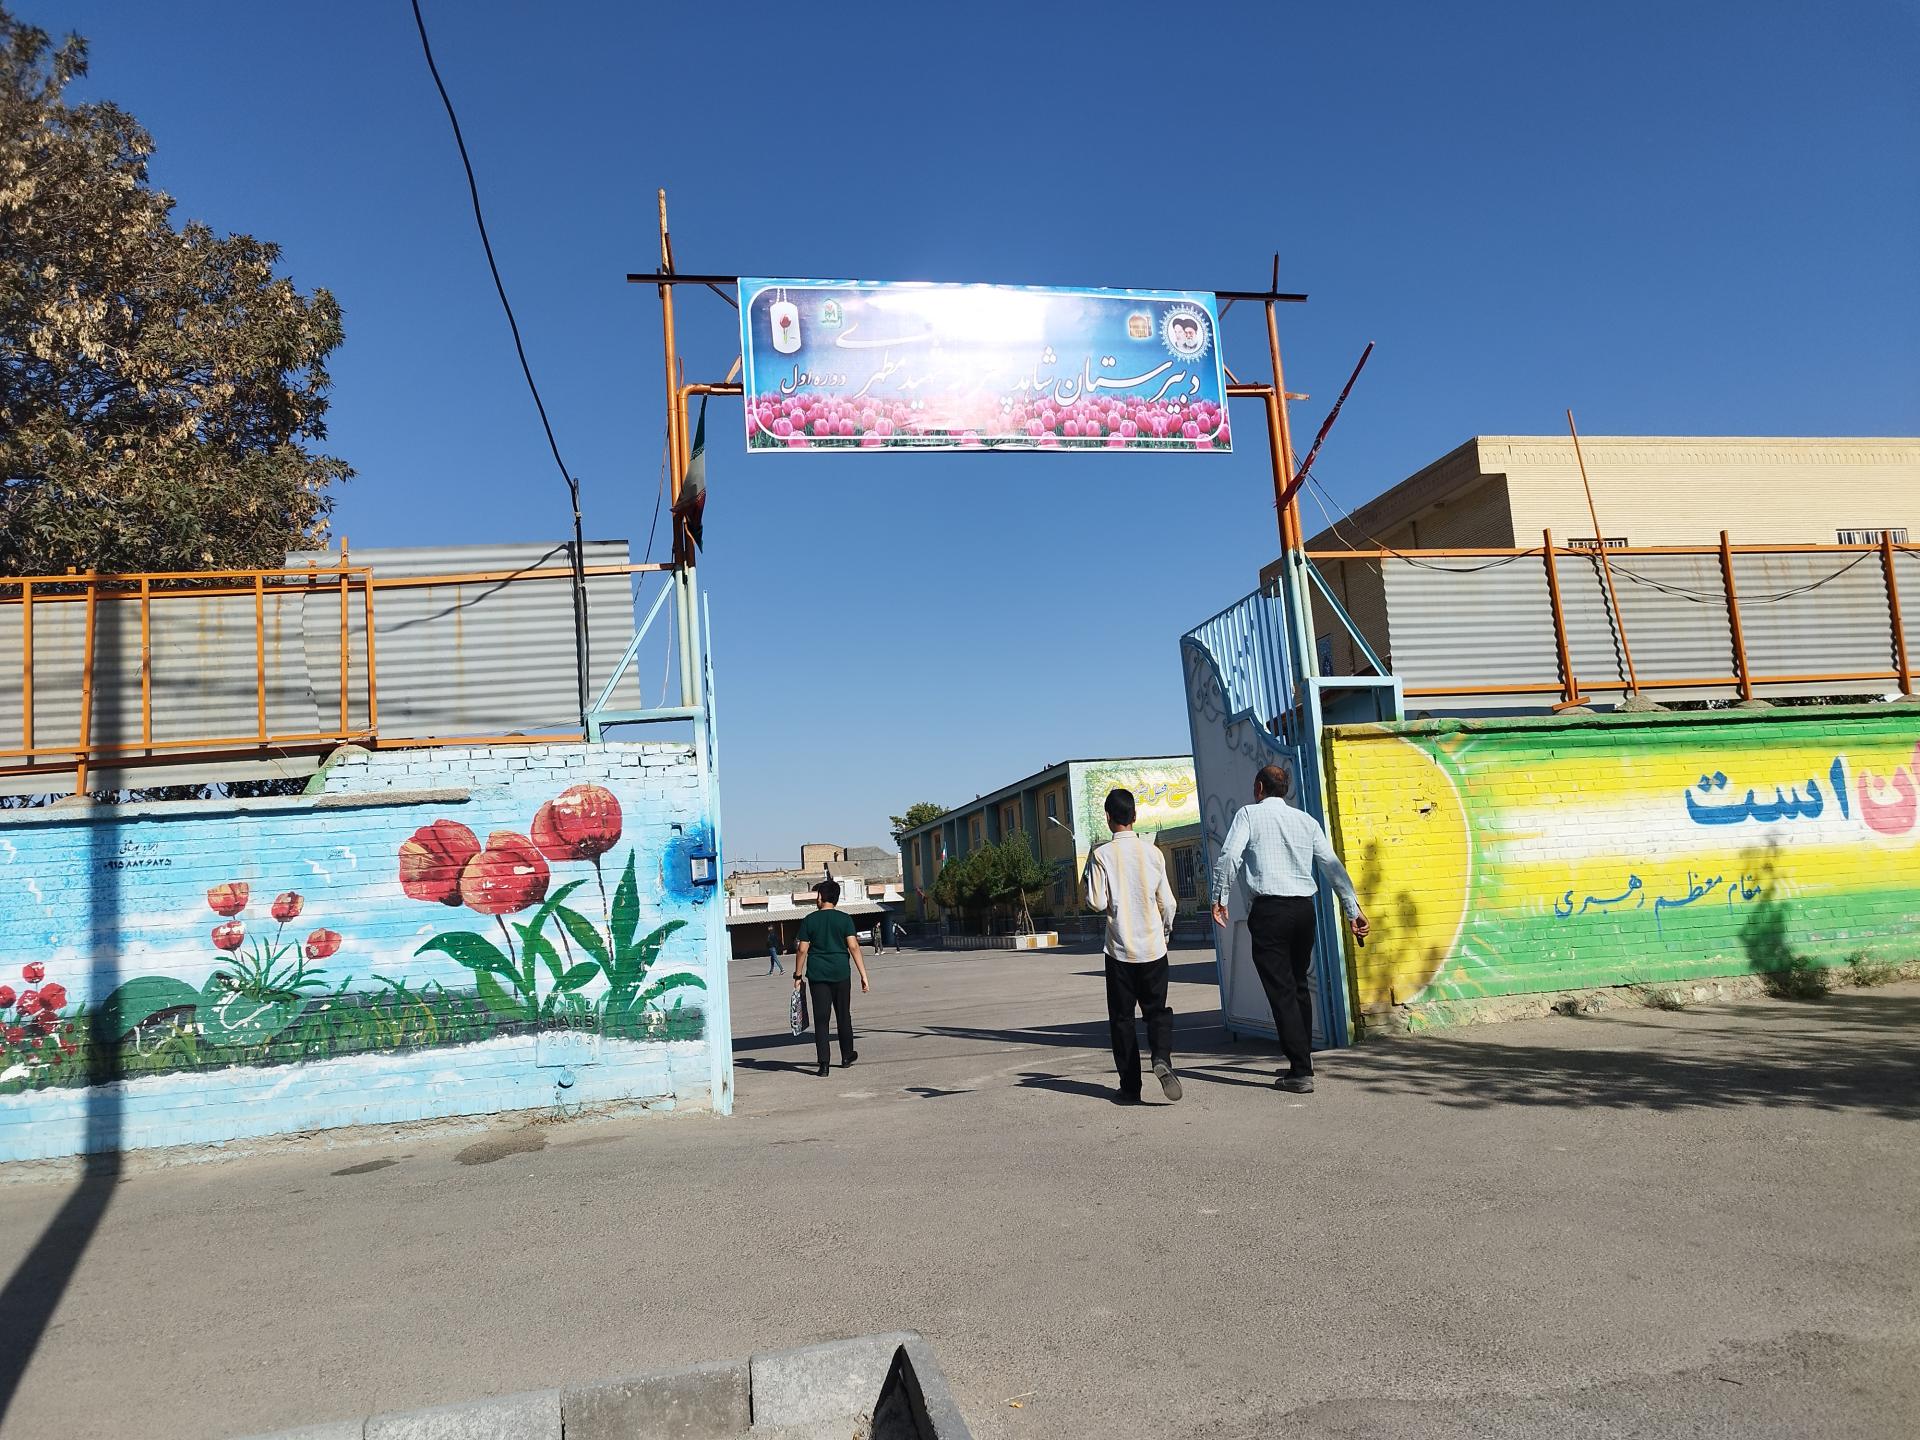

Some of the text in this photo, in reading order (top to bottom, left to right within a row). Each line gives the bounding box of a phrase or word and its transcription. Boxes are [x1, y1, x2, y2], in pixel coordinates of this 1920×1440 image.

[780, 363, 812, 395] اول
[1011, 346, 1053, 403] شاهد
[1054, 356, 1200, 414] دبیرستان
[1684, 756, 1849, 825] است
[1554, 869, 1762, 938] مقام معظم رهبری
